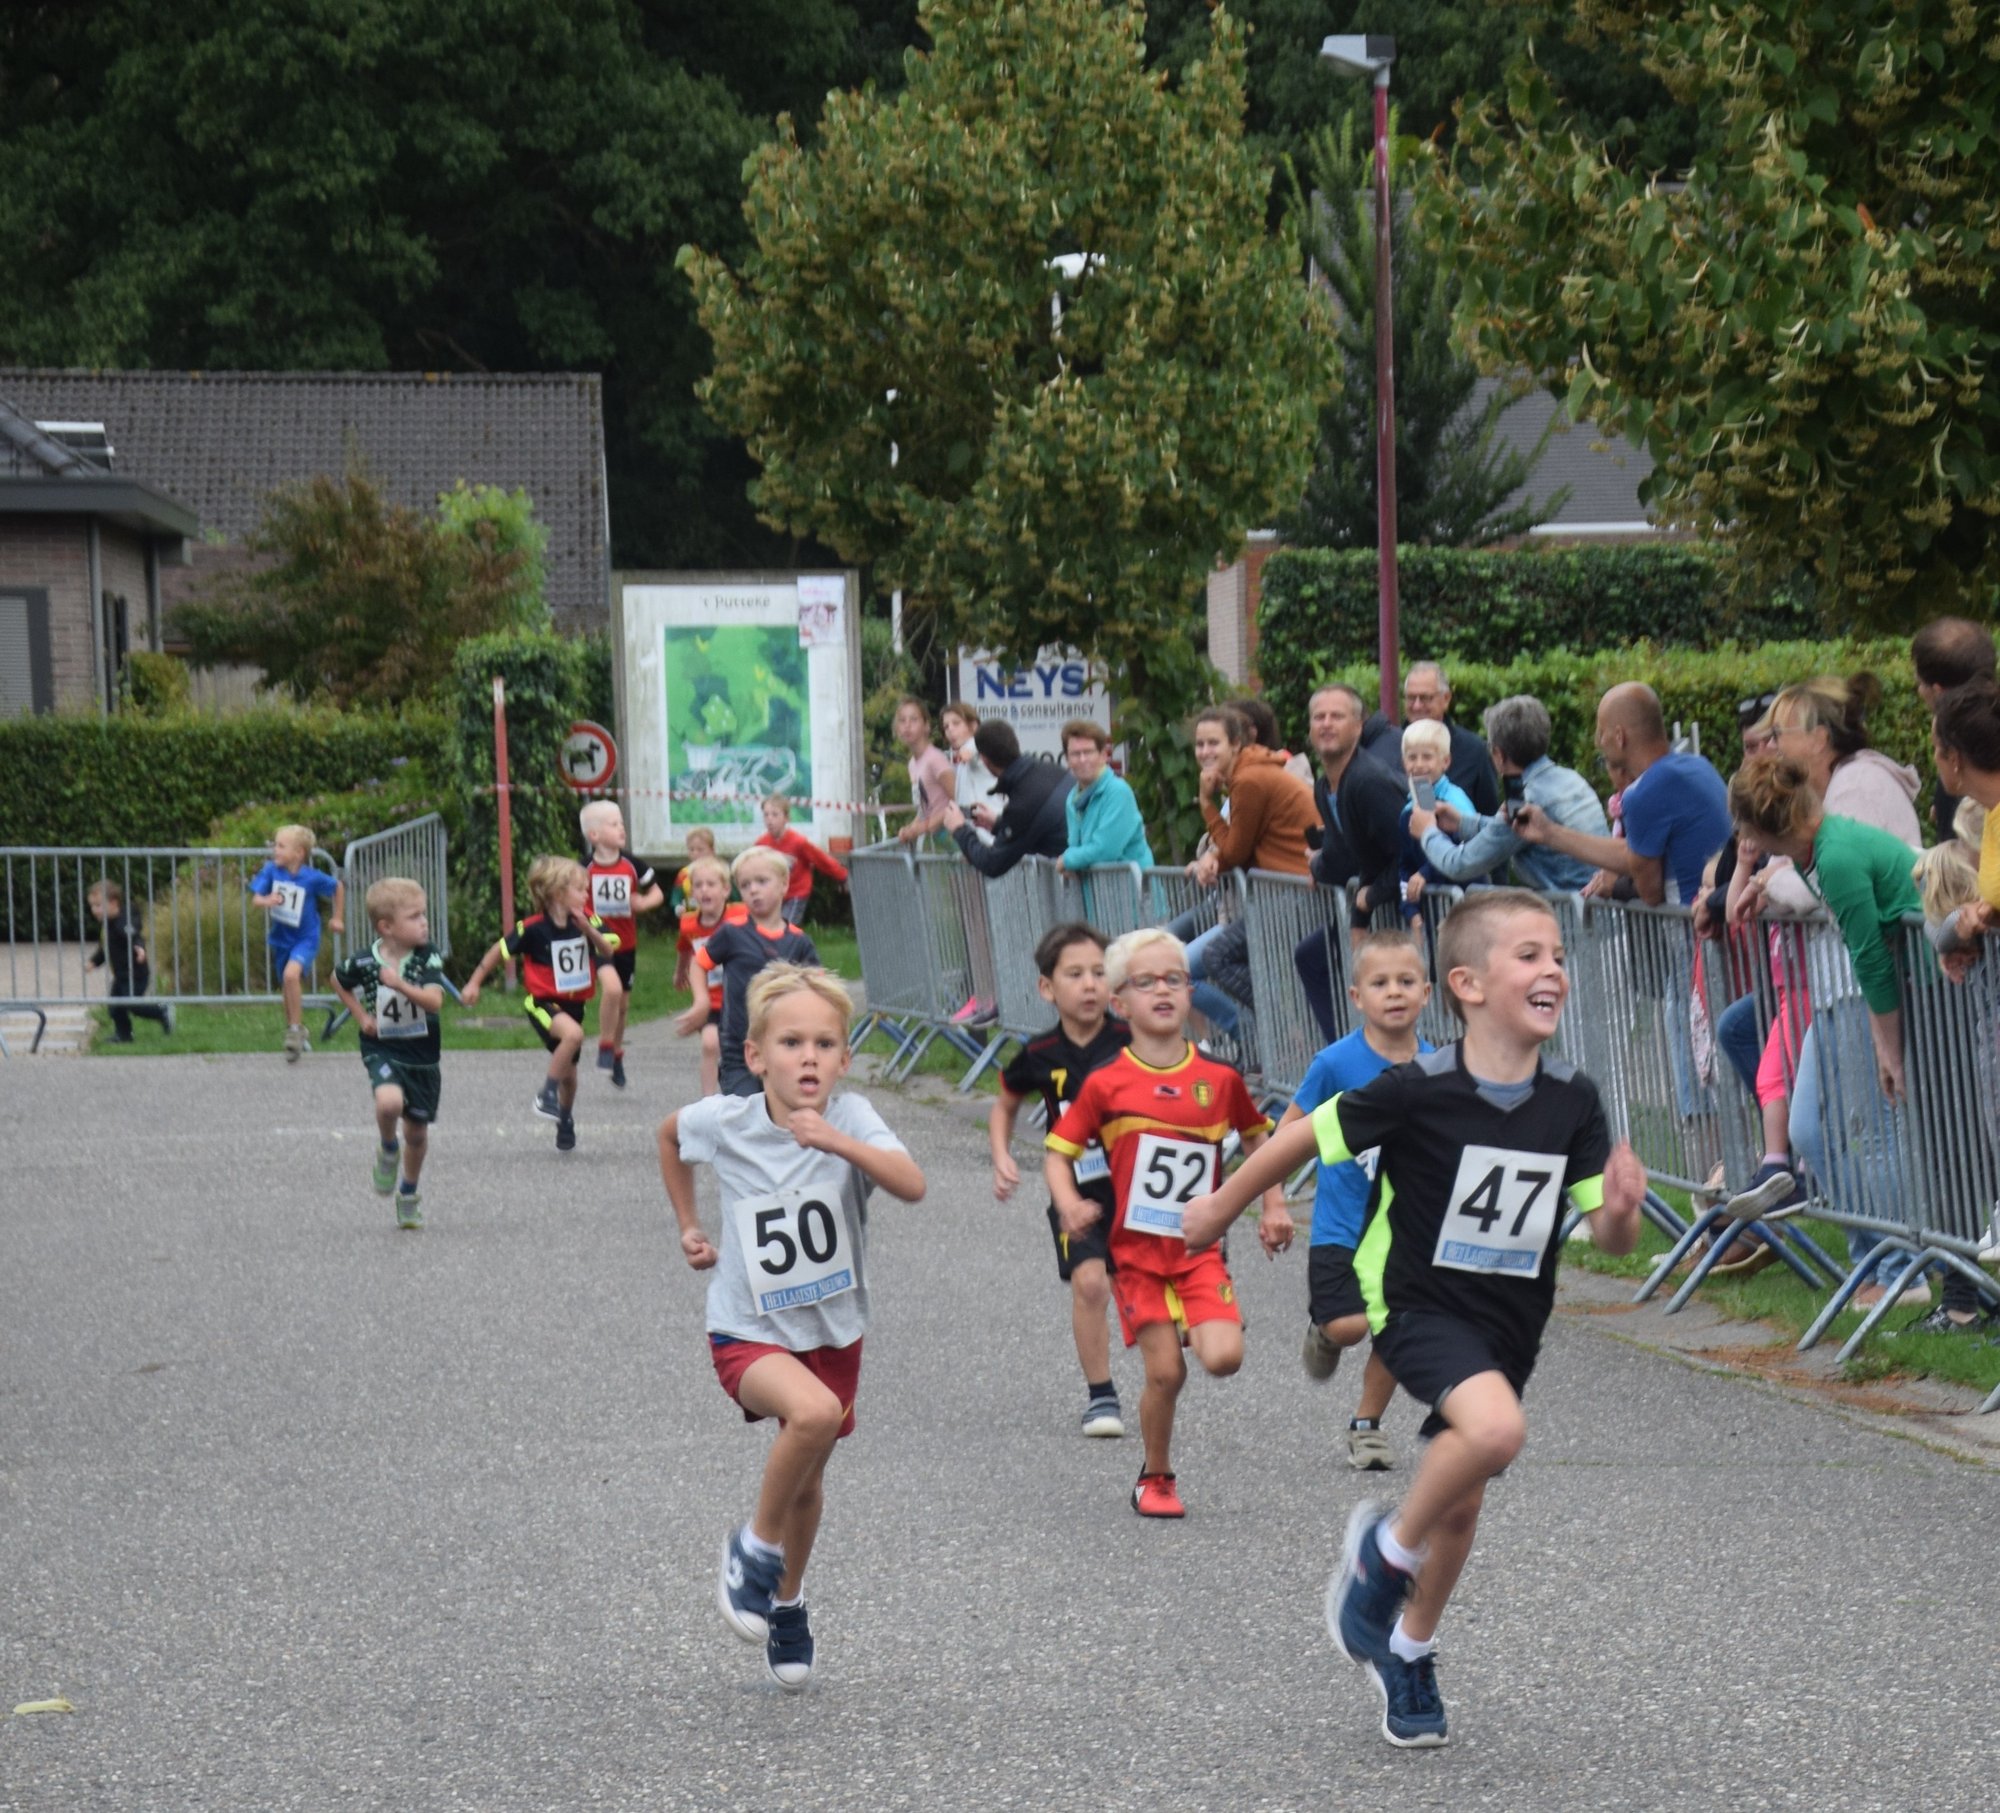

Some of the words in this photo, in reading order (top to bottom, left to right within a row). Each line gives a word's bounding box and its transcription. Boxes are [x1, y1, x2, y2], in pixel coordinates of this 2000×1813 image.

[976, 663, 1084, 699] NEYS
[1020, 701, 1095, 720] consultancy
[277, 885, 298, 910] 51
[597, 878, 626, 901] 48
[558, 944, 586, 974] 67
[382, 995, 418, 1023] 41
[1051, 1067, 1068, 1098] 7
[1144, 1146, 1207, 1204] 52
[1459, 1165, 1552, 1237] 47
[755, 1199, 838, 1275] 50
